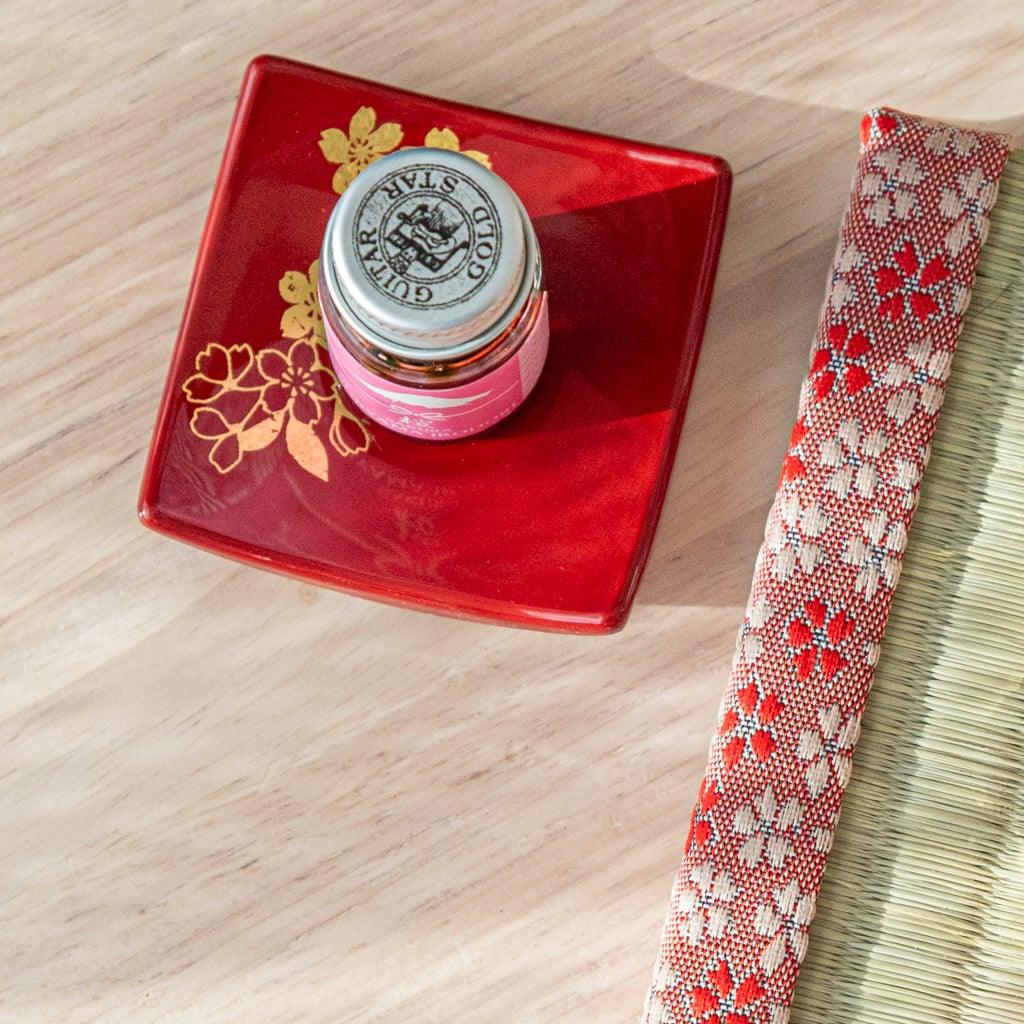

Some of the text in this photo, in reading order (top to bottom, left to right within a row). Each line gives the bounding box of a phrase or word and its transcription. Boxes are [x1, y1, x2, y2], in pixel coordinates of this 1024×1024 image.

[381, 172, 459, 200] STAR
[358, 206, 496, 303] GOLD GUITAR
